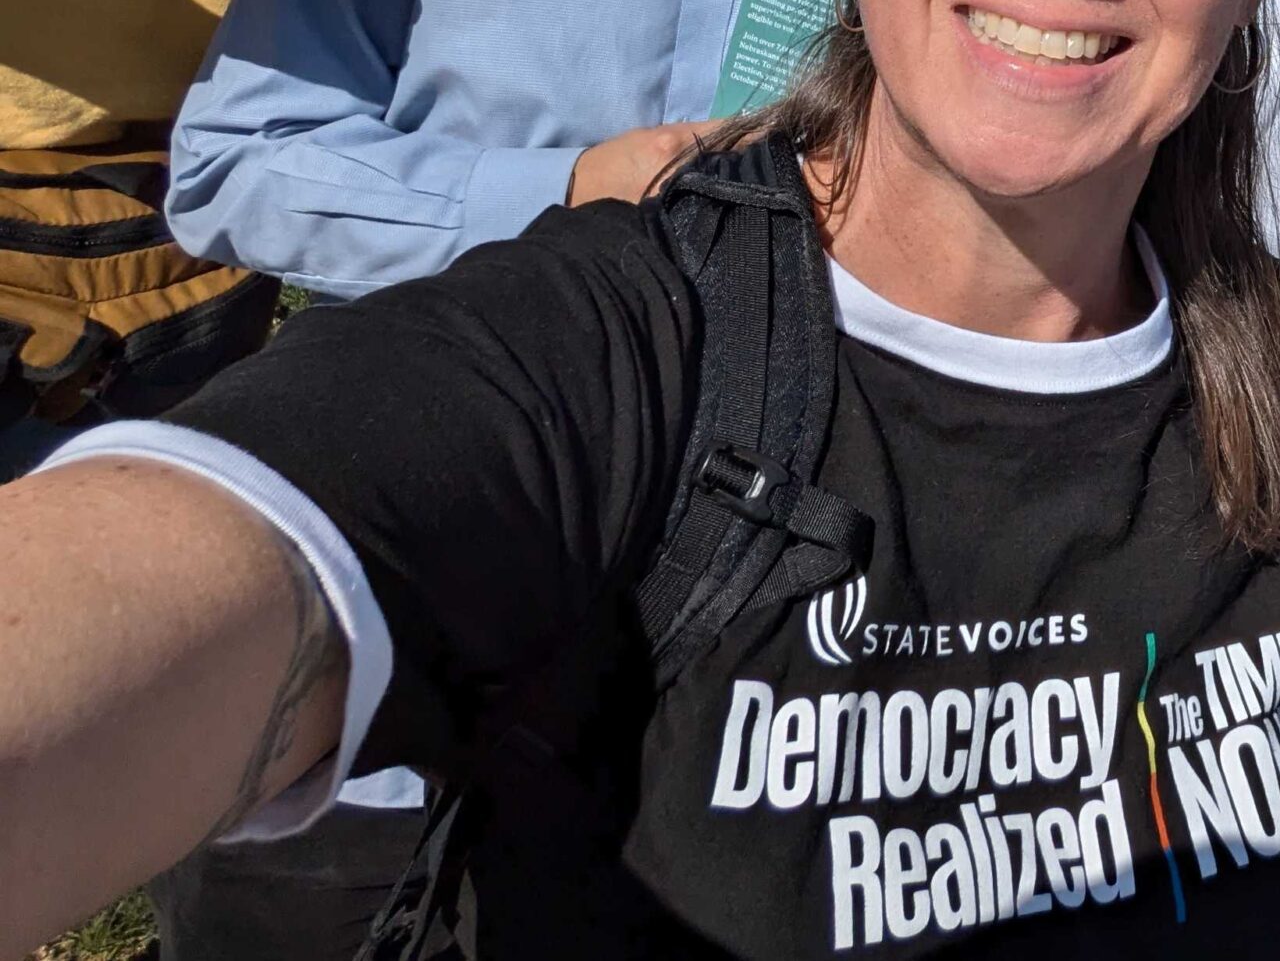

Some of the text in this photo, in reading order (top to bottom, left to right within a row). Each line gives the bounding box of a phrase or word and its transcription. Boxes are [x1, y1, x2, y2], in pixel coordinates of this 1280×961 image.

[711, 672, 1120, 809] Democracy
[1160, 693, 1204, 742] The
[829, 778, 1137, 952] Realized
